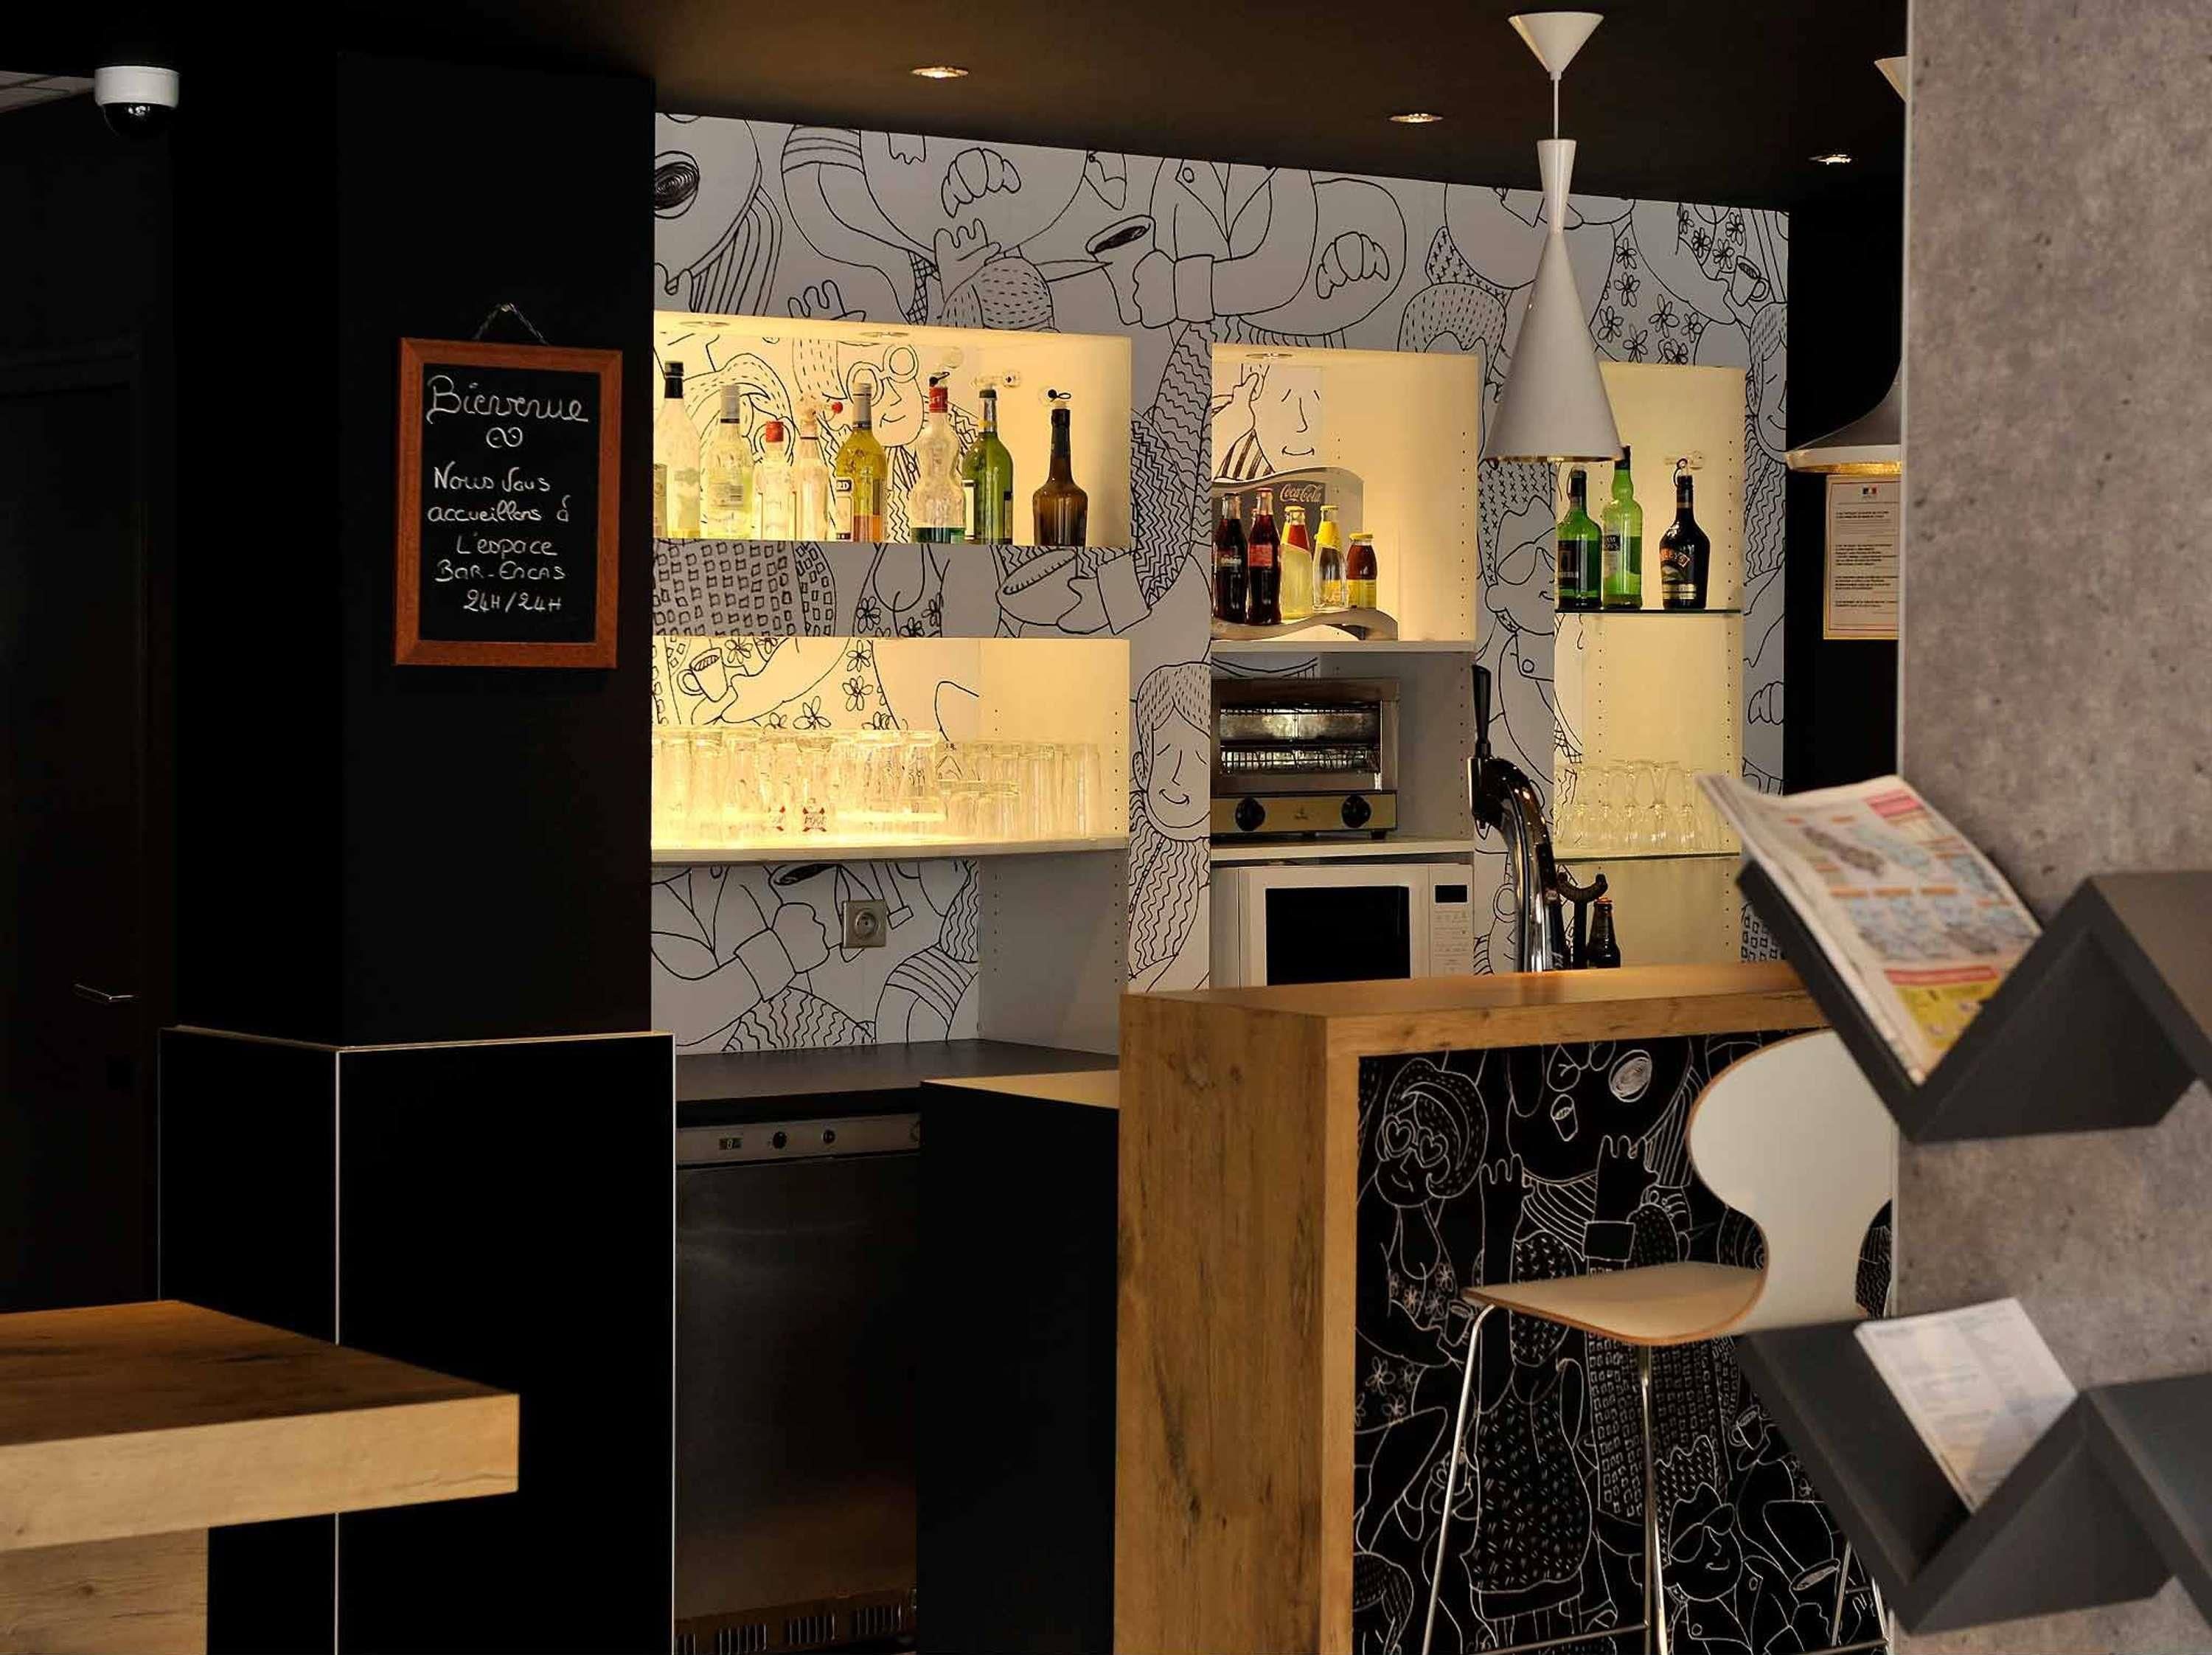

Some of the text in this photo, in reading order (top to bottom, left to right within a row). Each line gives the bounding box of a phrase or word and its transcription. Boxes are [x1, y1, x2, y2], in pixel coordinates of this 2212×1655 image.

[427, 374, 589, 425] Bienvenue
[434, 460, 551, 493] Nous Vous
[456, 531, 558, 561] L'espace
